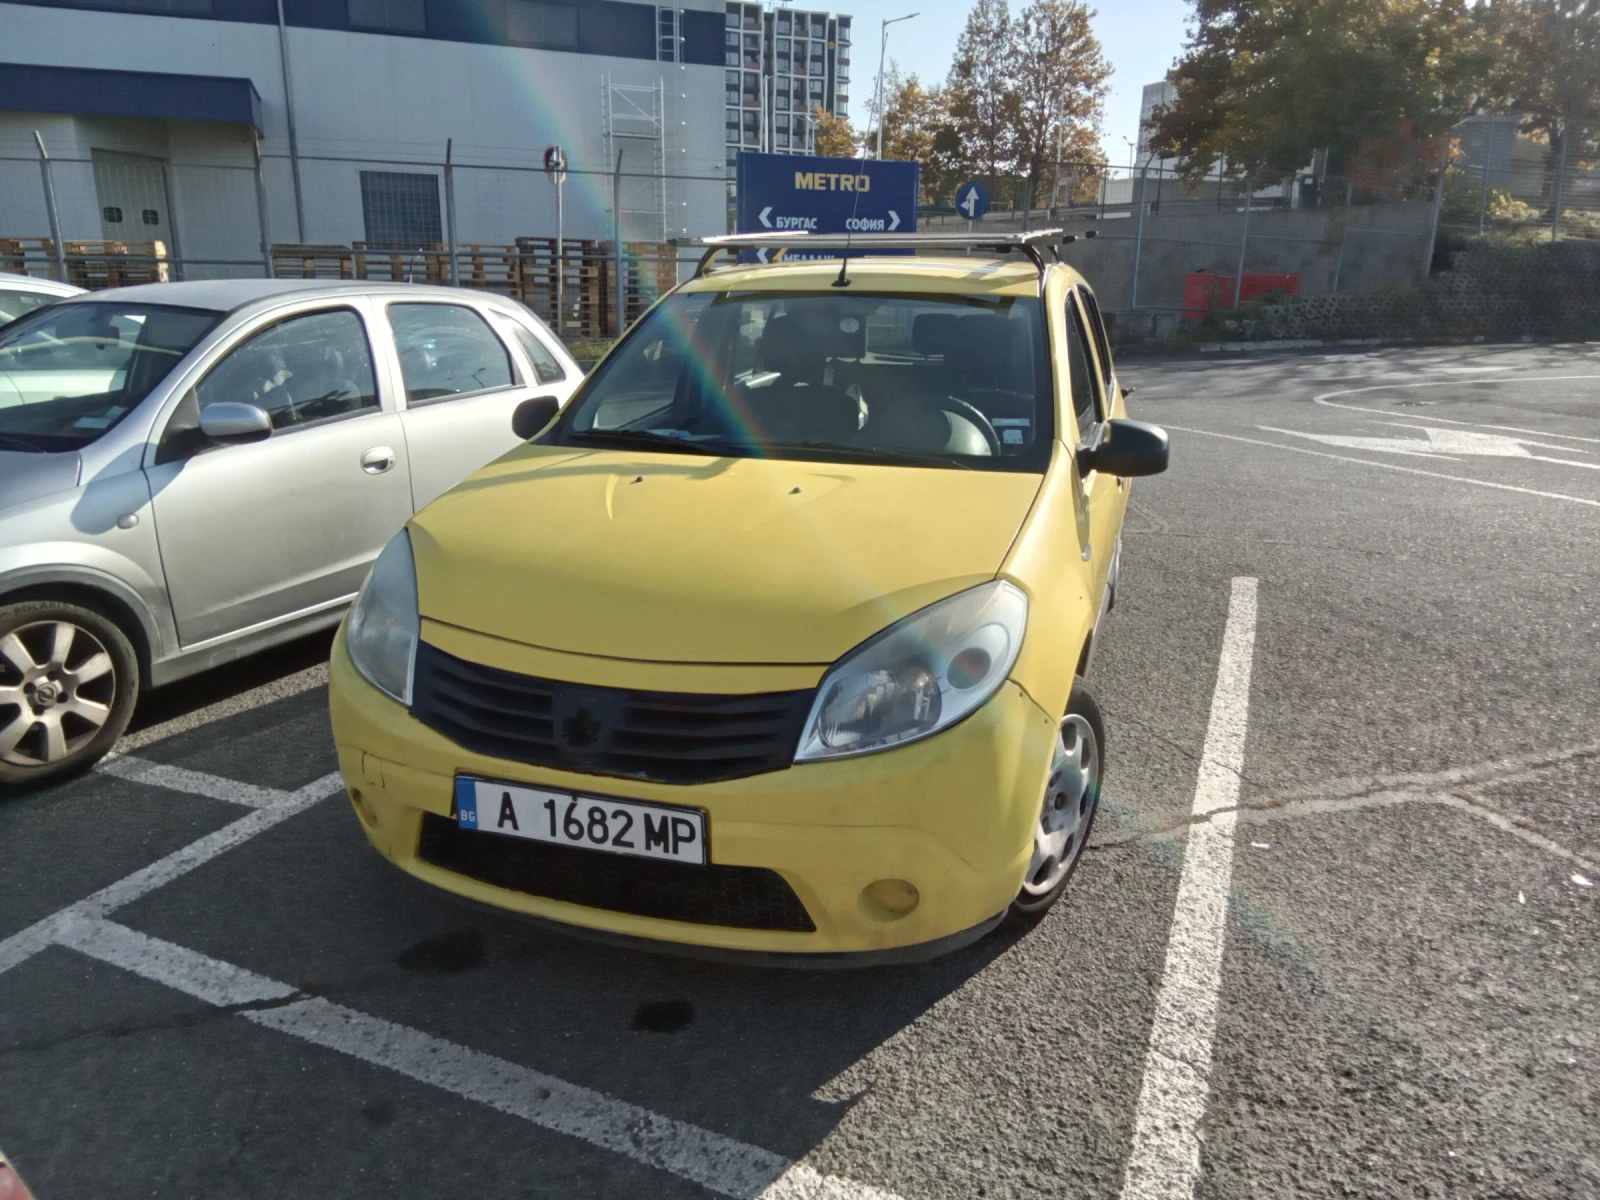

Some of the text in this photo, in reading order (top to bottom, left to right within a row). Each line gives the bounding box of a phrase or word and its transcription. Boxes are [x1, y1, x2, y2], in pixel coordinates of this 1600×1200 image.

[795, 172, 870, 192] METRO
[776, 216, 818, 229] БУРГАС
[845, 218, 885, 231] СОФИЯ
[460, 809, 476, 822] BG
[497, 791, 697, 855] A 1682 MP
